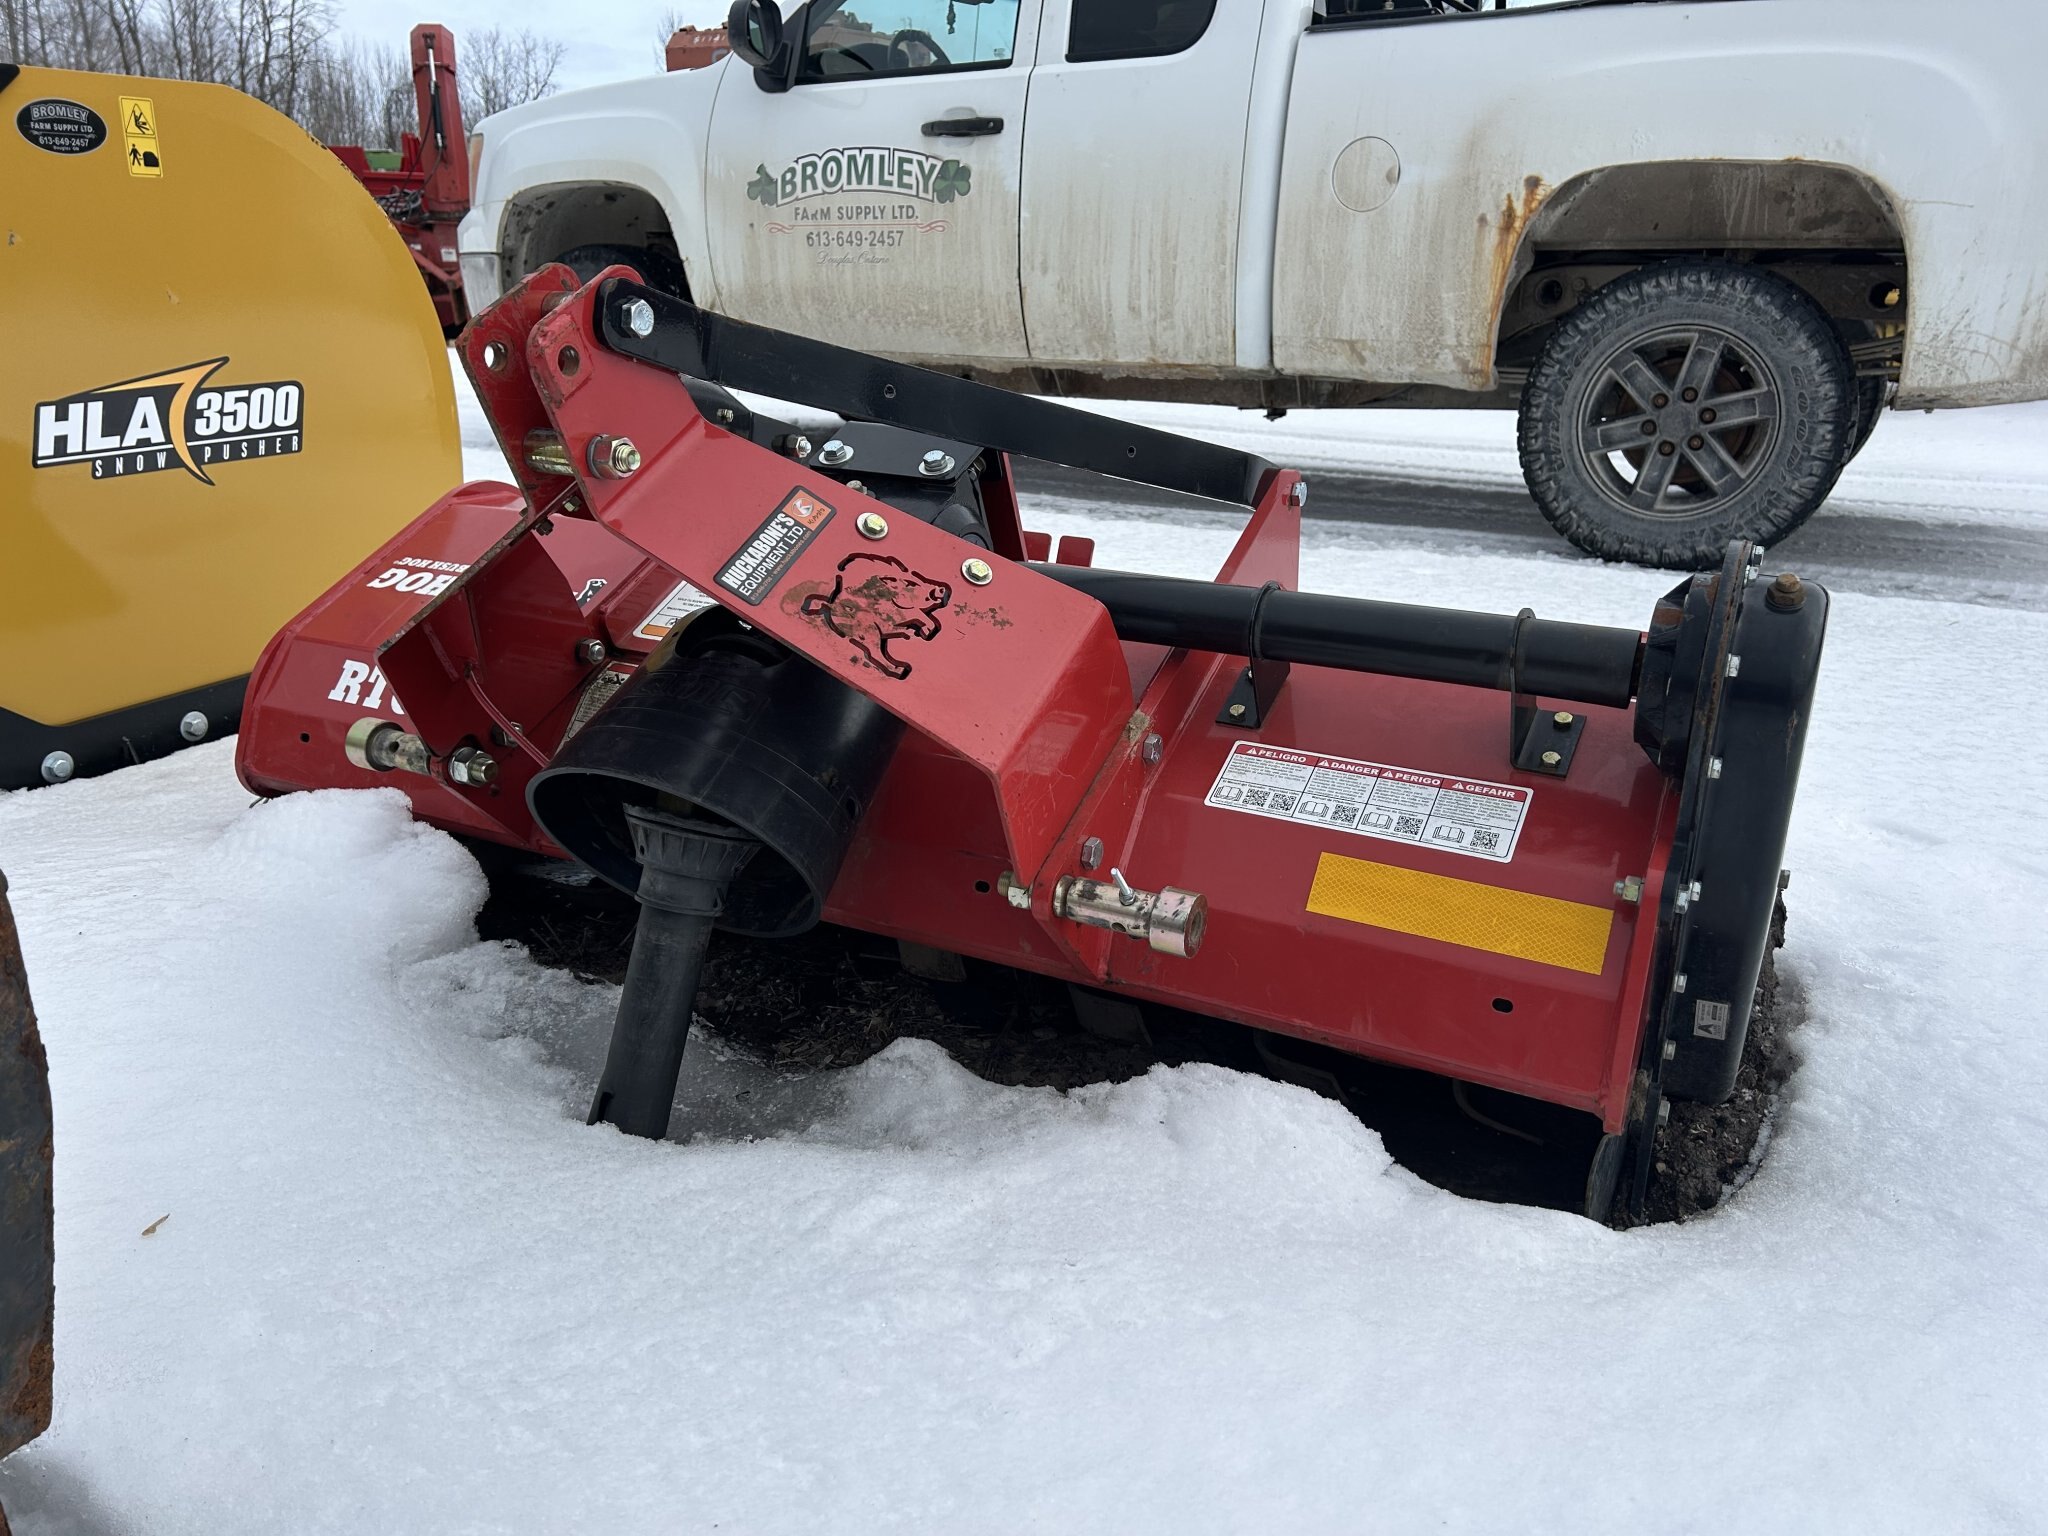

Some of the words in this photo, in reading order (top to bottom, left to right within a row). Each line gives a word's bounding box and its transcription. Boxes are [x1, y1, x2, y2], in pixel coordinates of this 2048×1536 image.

[31, 104, 88, 122] BROMLEY
[30, 121, 51, 130] FARM
[53, 123, 79, 132] SUPPLY
[81, 125, 95, 133] LTD.
[39, 136, 89, 147] 613-649-2457
[778, 150, 941, 204] BROMLEY
[794, 206, 831, 221] FARM
[837, 205, 887, 220] SUPPLY
[892, 204, 919, 220] LTD.
[37, 396, 166, 458] HLA
[194, 385, 300, 436] 3500
[95, 451, 167, 478] SNOW
[204, 436, 299, 463] PUSHER
[721, 512, 795, 590] HUCKABONE'S
[435, 561, 471, 573] BUSH
[739, 541, 790, 597] EQUIPMENT
[787, 526, 806, 545] LTD.
[327, 659, 405, 715] RT
[1258, 749, 1307, 763] PELIGRO
[1331, 761, 1380, 776] DANGER
[1395, 771, 1441, 786] PERIGO
[1465, 784, 1516, 799] GEFAHR
